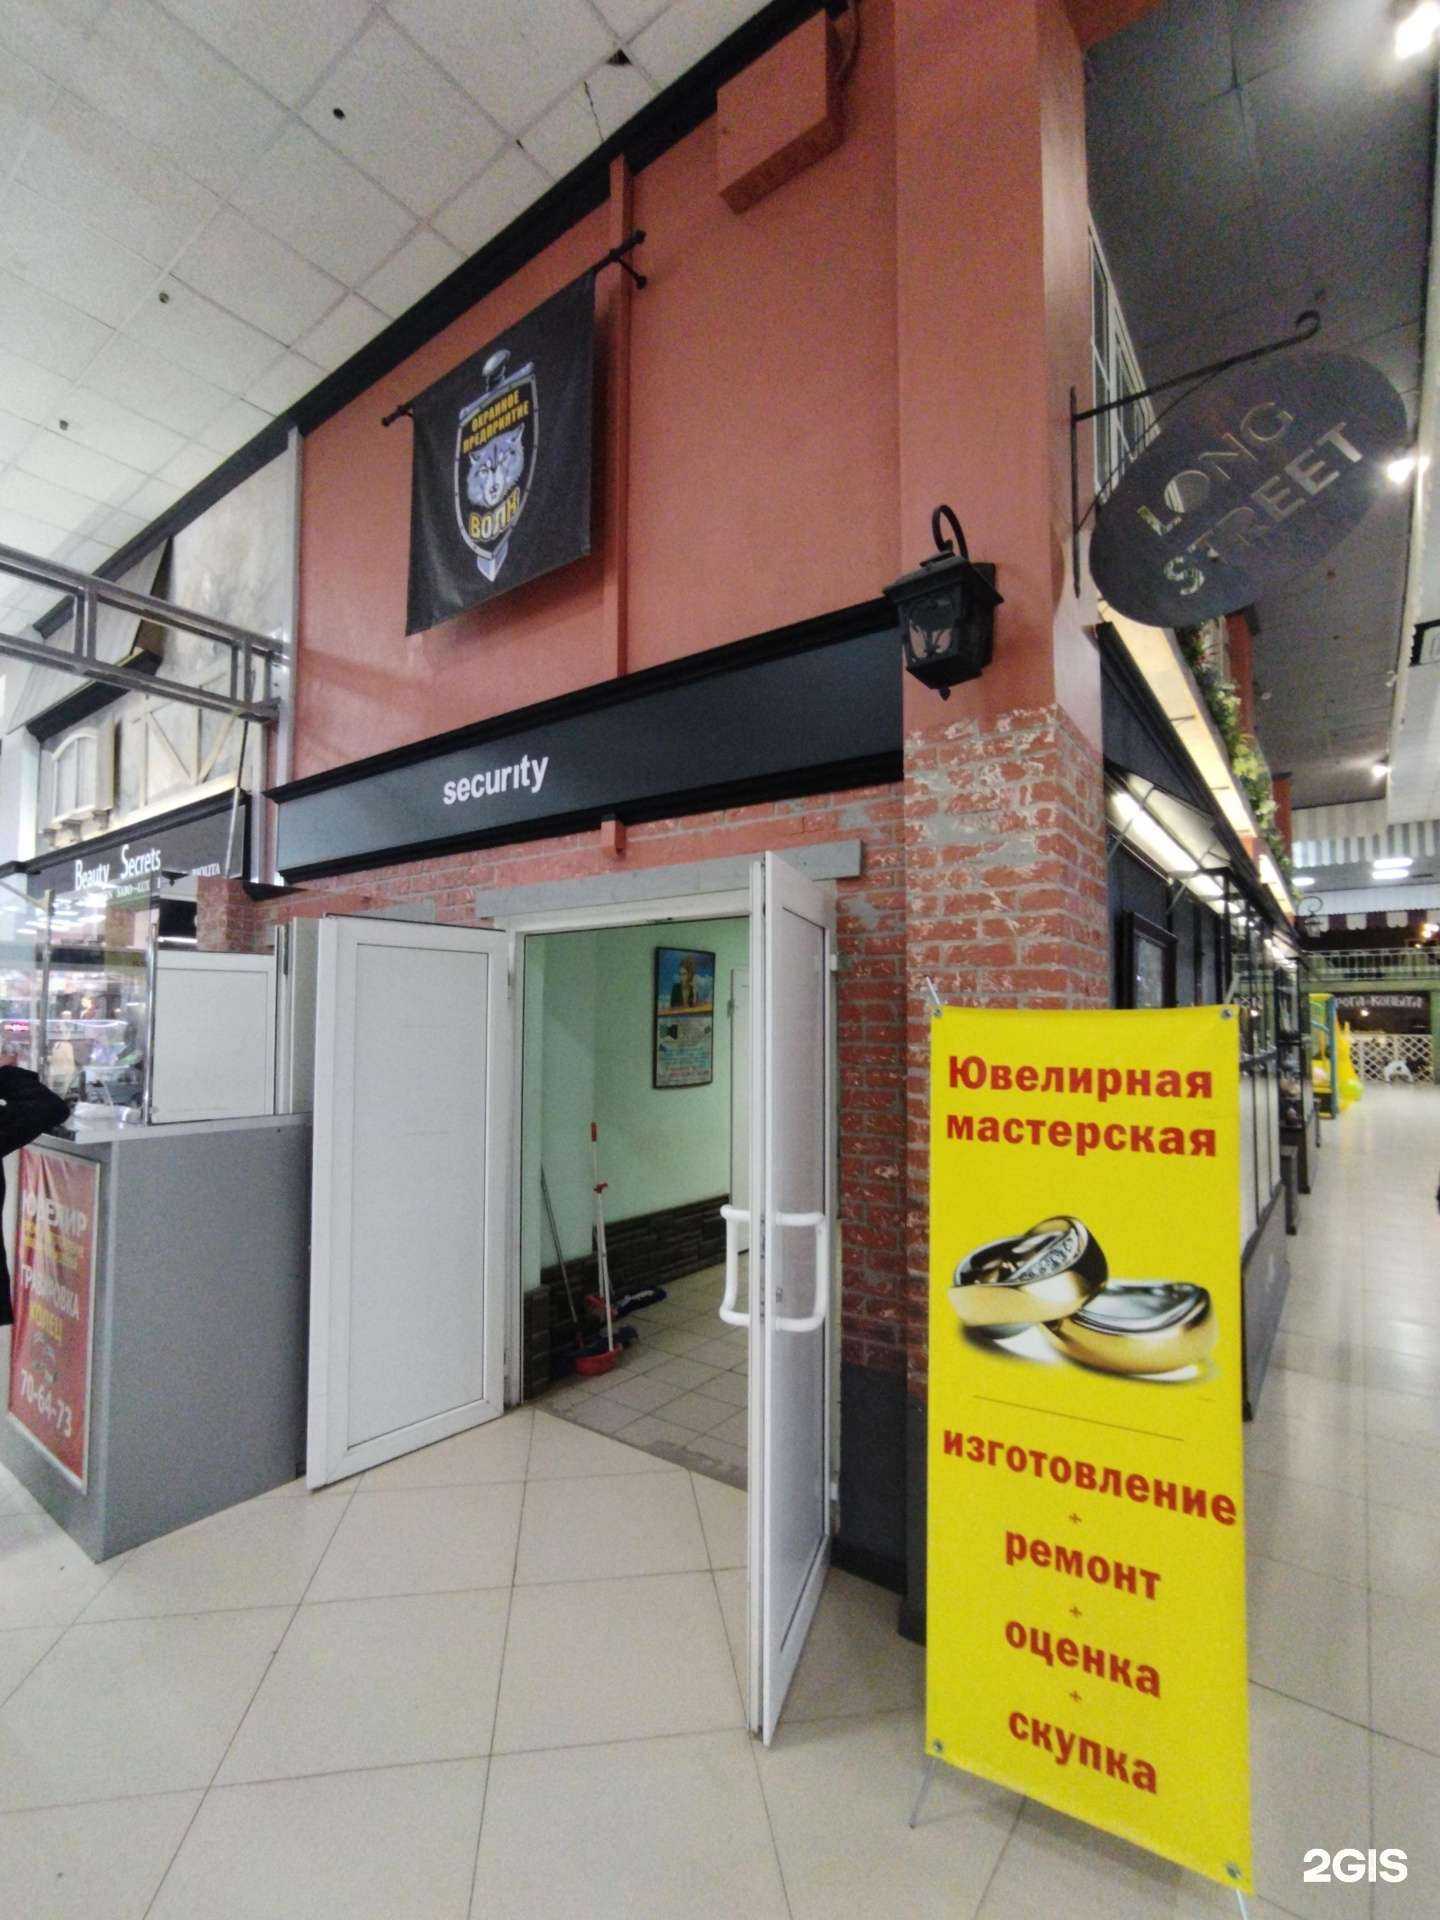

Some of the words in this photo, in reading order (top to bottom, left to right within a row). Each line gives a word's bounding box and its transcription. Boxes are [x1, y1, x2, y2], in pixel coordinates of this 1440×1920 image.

[463, 400, 529, 454] ПРЕДПРИЯТИЕ
[471, 389, 519, 432] ОХРАННОЕ
[1137, 402, 1295, 537] LONG
[1162, 421, 1364, 596] STREET
[443, 754, 549, 805] security
[75, 859, 110, 890] Beauty
[120, 844, 161, 879] Secrets
[949, 1055, 1213, 1103] Ювелирная
[946, 1114, 1217, 1157] мастерская
[22, 1190, 87, 1238] ЮЕЛИР
[21, 1368, 73, 1438] 70-64-73
[943, 1429, 1237, 1526] изготовление
[1005, 1530, 1161, 1601] ремонт
[1004, 1620, 1161, 1699] оценка
[1008, 1711, 1157, 1794] скупка
